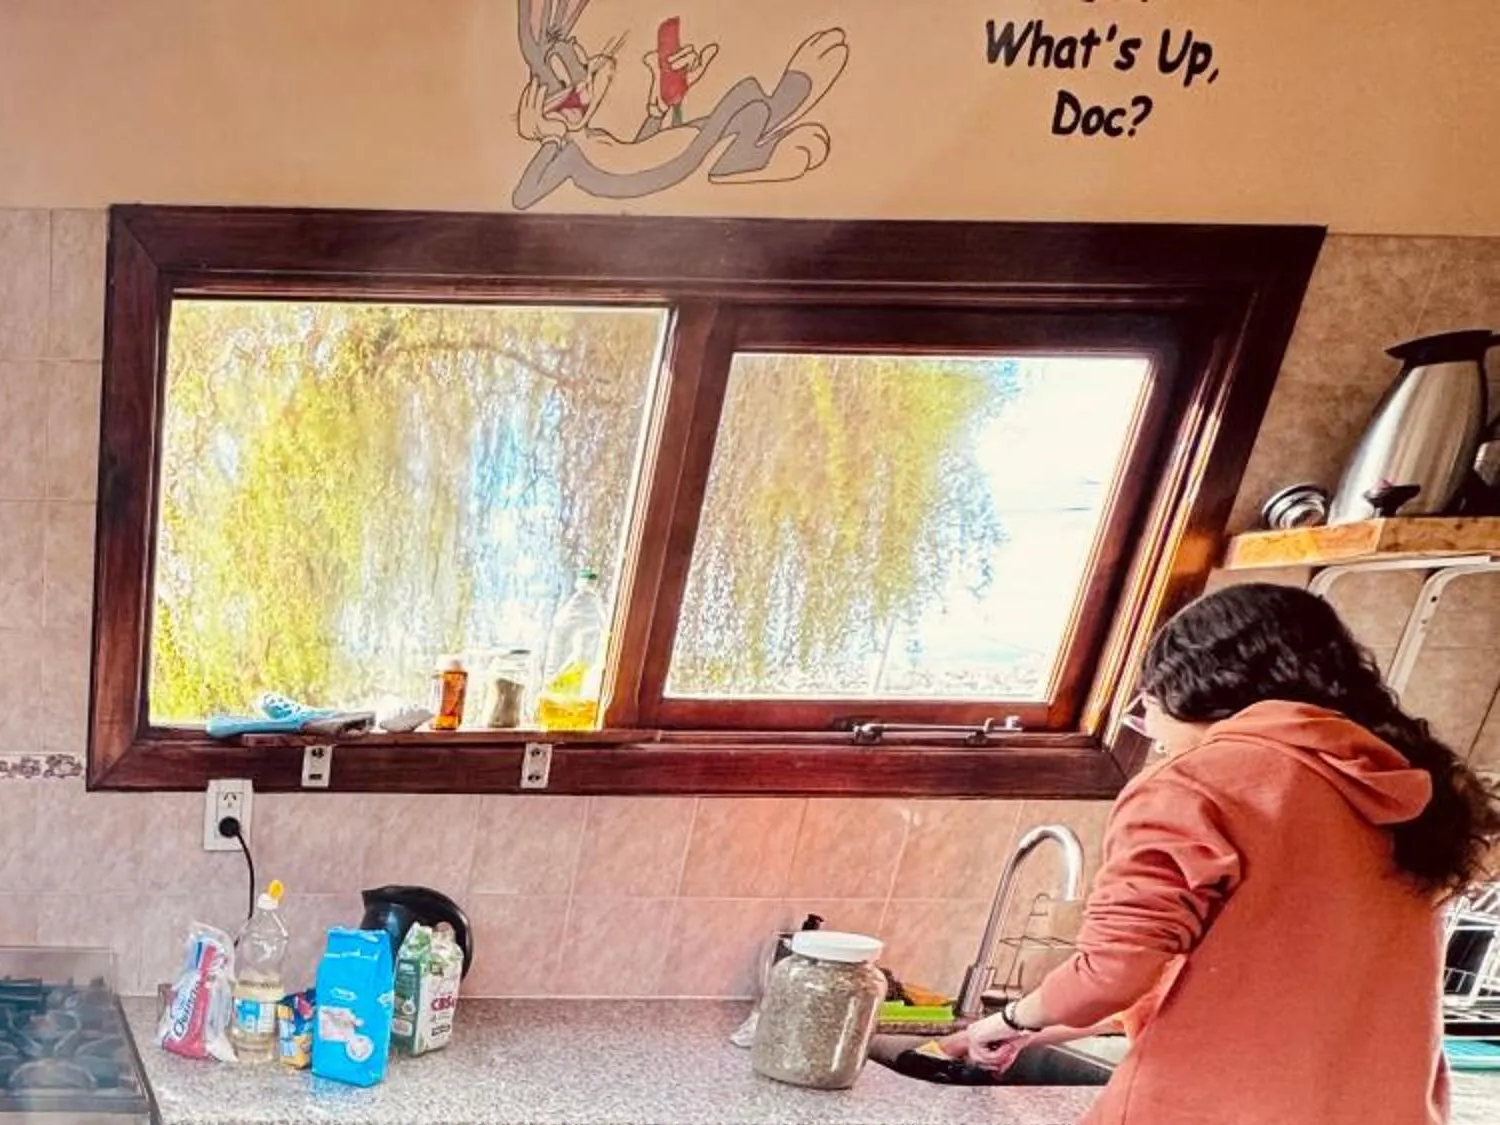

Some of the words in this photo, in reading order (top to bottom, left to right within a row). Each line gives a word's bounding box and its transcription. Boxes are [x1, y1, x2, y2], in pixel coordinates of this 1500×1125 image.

[985, 19, 1143, 72] What's
[1157, 28, 1220, 88] Up,
[1051, 89, 1153, 138] Doc?
